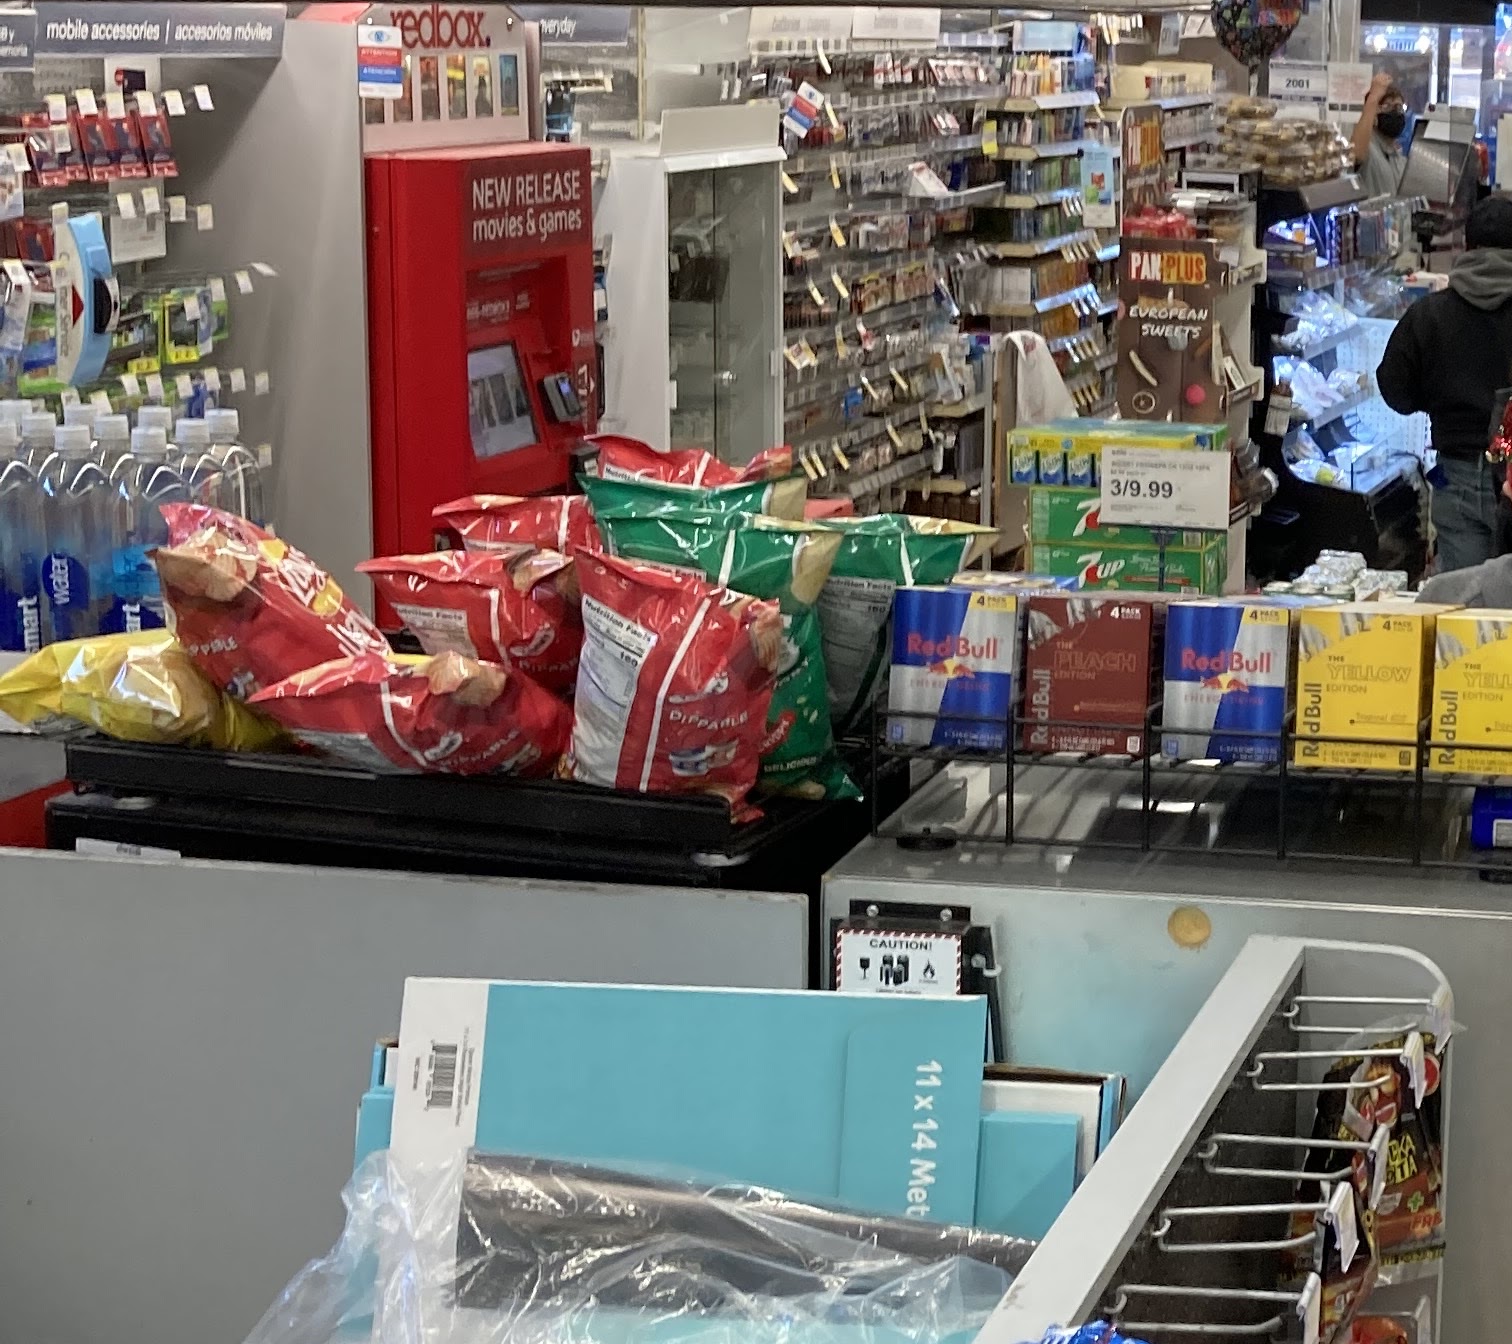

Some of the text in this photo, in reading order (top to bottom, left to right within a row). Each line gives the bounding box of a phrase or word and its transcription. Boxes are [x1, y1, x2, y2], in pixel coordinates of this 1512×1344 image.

[46, 18, 272, 42] mobile accessories accesorios móviles
[1285, 77, 1310, 89] 2001
[472, 169, 581, 211] NEW RELEASE
[472, 207, 582, 242] movies & games
[1163, 252, 1206, 284] PLUS
[1129, 305, 1208, 321] EUROPEAN
[1141, 324, 1201, 339] SWEETS
[1110, 478, 1173, 498] 3/9.99
[52, 553, 71, 606] water
[1077, 551, 1125, 589] 7UP
[976, 594, 985, 606] 4
[436, 611, 463, 621] Facts
[584, 598, 653, 642] Nutrition Facts
[1111, 606, 1141, 619] 4 PACK
[1249, 609, 1258, 621] 4
[1382, 619, 1391, 631] 4
[907, 632, 998, 659] Red Bull
[1056, 640, 1074, 650] THE
[1054, 650, 1136, 673] PEACH
[1181, 648, 1271, 673] Red Bull
[1328, 655, 1345, 663] THE
[1464, 662, 1481, 671] THE
[1054, 670, 1097, 680] EDITION
[1328, 664, 1412, 683] YELLOW
[1033, 669, 1050, 705] Bull
[1326, 683, 1367, 694] EDITION
[1304, 683, 1322, 719] Bull
[1462, 692, 1503, 702] EDITION
[1440, 690, 1458, 726] Bull
[669, 709, 748, 730] DIPPABLE
[869, 939, 932, 951] CAUTION!
[916, 1060, 943, 1087] 11
[913, 1094, 934, 1111] x
[911, 1118, 939, 1151] 14
